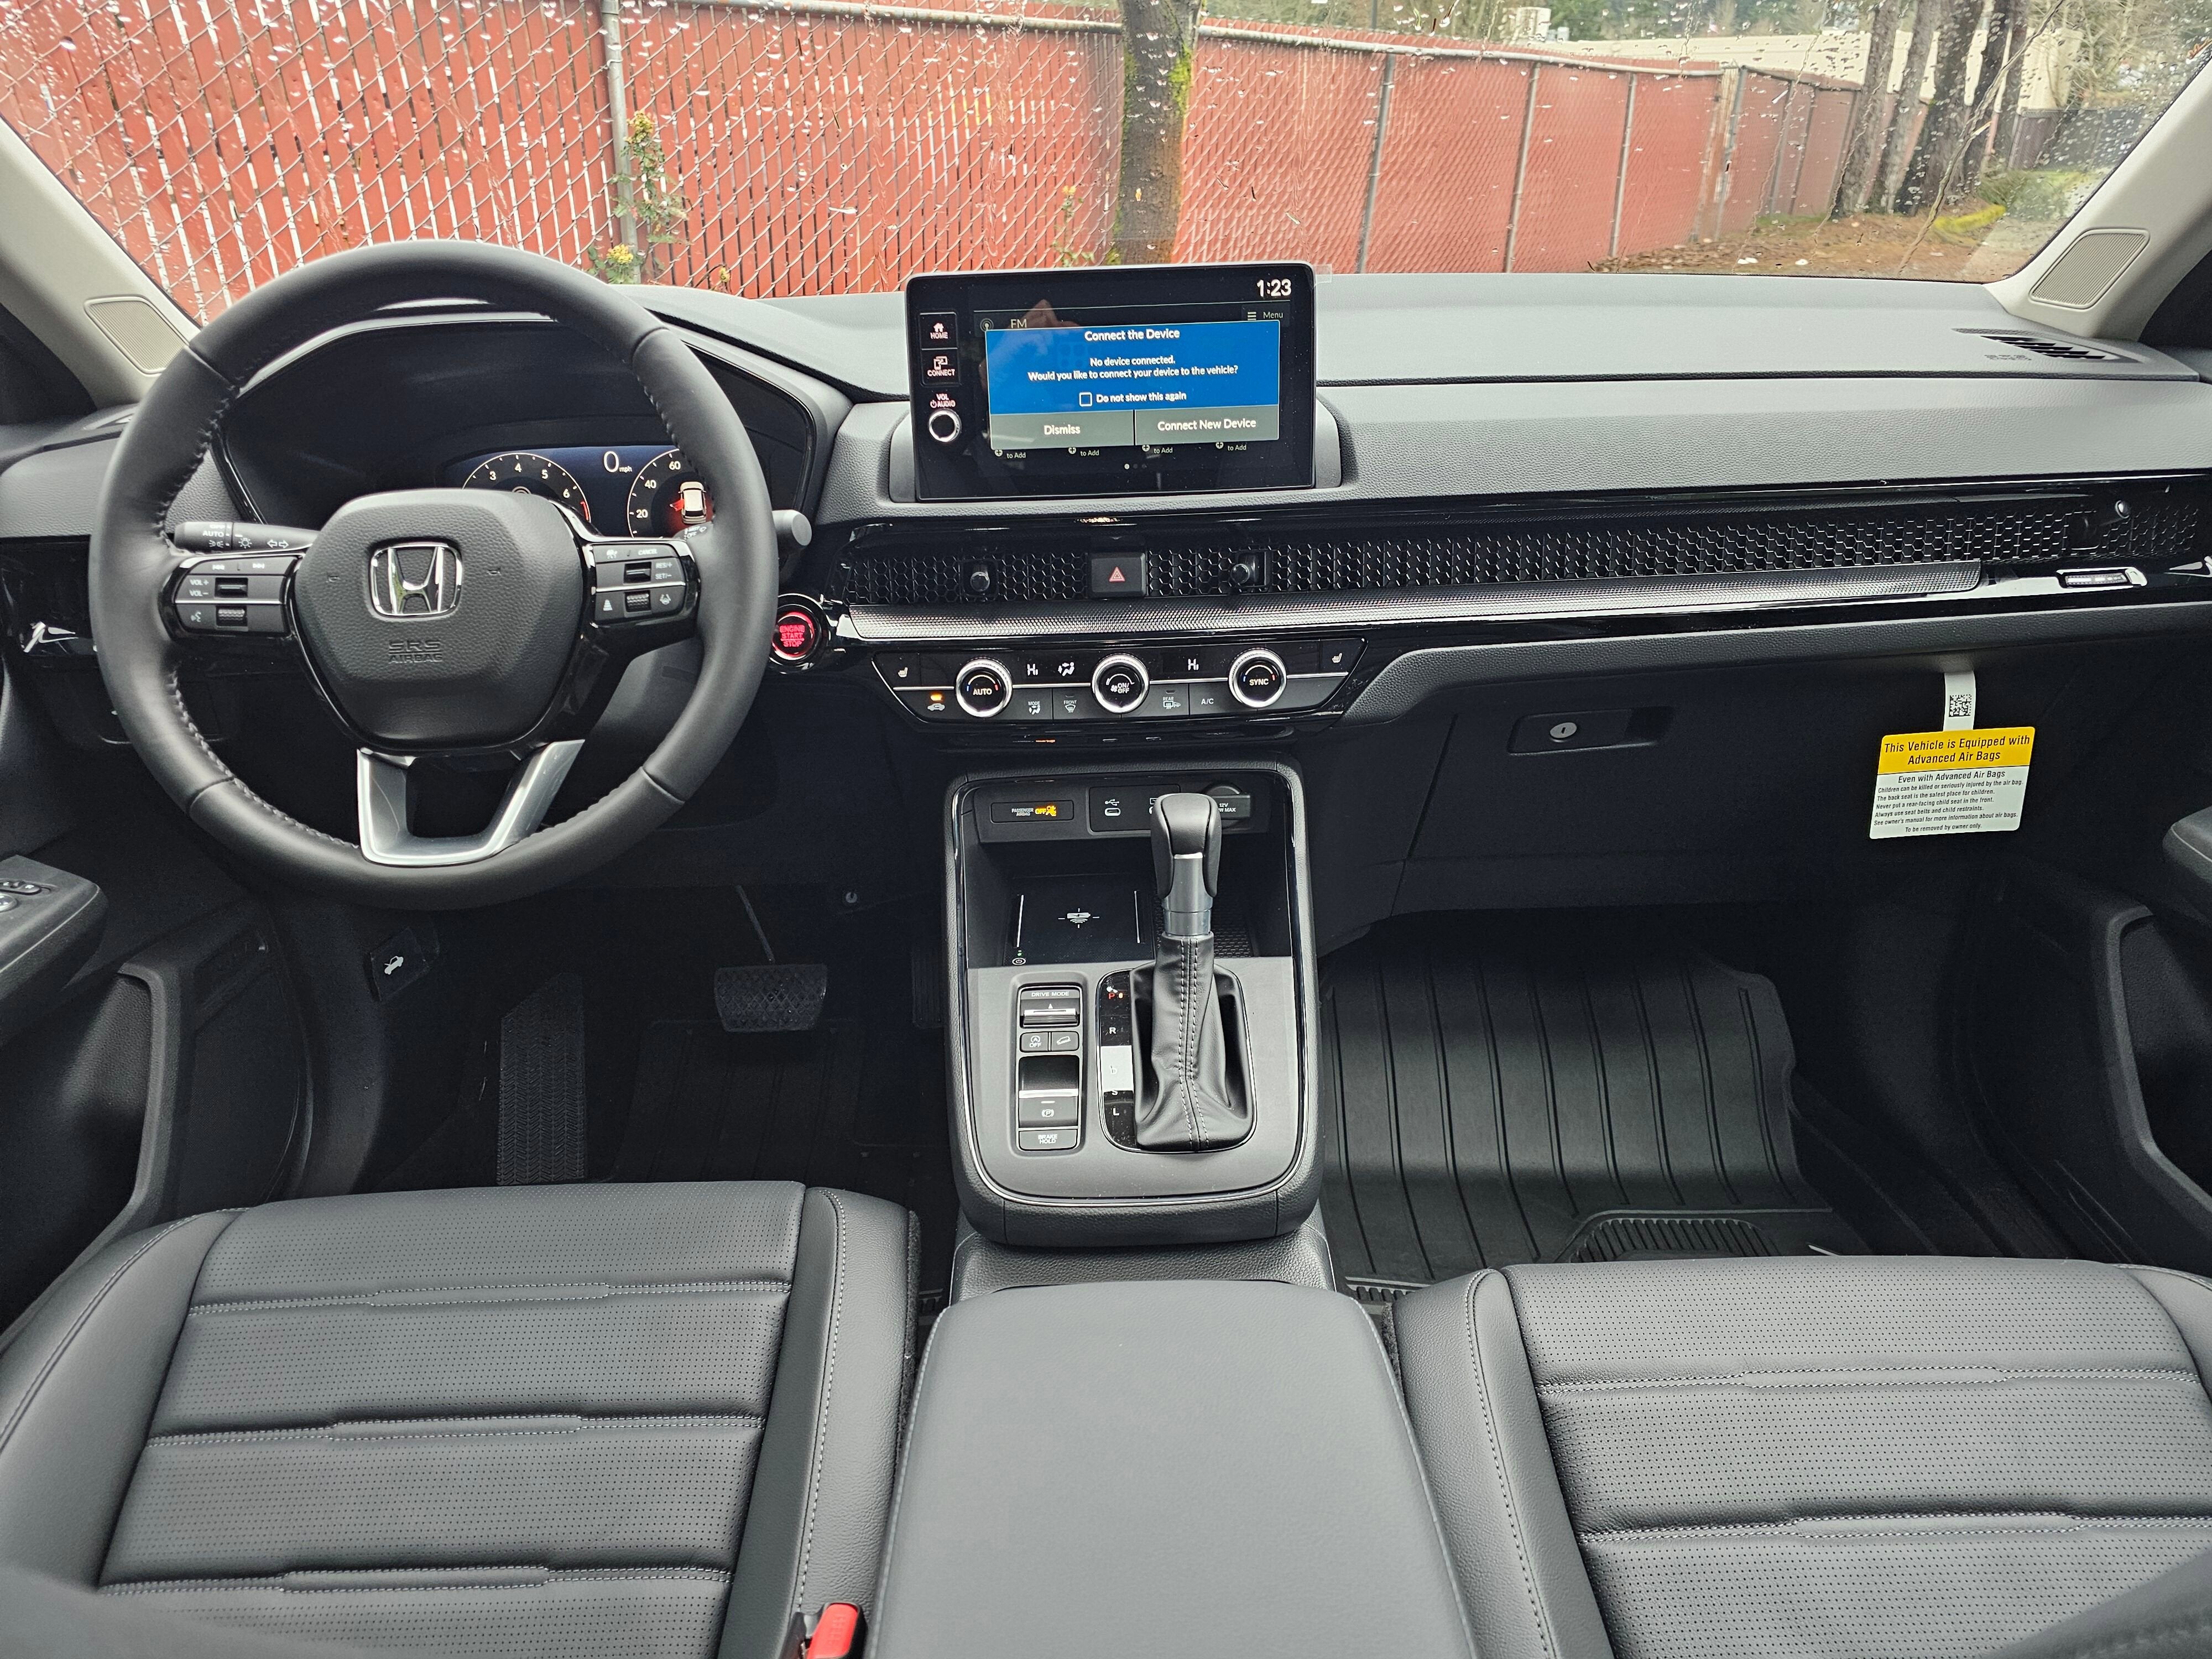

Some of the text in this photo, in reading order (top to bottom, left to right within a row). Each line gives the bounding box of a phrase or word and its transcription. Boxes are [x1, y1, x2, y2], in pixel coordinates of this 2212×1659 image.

[1257, 279, 1291, 296] 1:23
[1011, 319, 1027, 328] FM
[1084, 328, 1180, 341] Connect the Device
[1090, 355, 1175, 367] No device connected.
[1028, 371, 1055, 381] Would
[1056, 373, 1072, 383] you
[1073, 371, 1088, 379] like
[1099, 369, 1131, 379] connect
[1134, 369, 1151, 379] your
[1154, 367, 1179, 376] device
[1191, 367, 1204, 375] the
[1206, 365, 1238, 375] vehicle?
[1096, 392, 1186, 403] Do not show this again
[1044, 424, 1080, 435] Dismiss
[1157, 419, 1256, 431] Connect New Device
[514, 463, 521, 472] 4
[603, 451, 632, 474] 0 mph
[669, 461, 681, 471] 60
[489, 471, 496, 481] 3
[541, 469, 548, 479] 5
[645, 479, 656, 489] 40
[563, 489, 570, 498] 6
[636, 509, 648, 518] 20
[388, 641, 441, 652] SRS
[388, 653, 443, 664] AIRBAG
[1885, 735, 2030, 753] This Vehicle is Equipped with
[1908, 752, 2000, 765] Advanced Air Bags
[1936, 772, 1971, 780] Advanced
[1113, 1108, 1120, 1116] L
